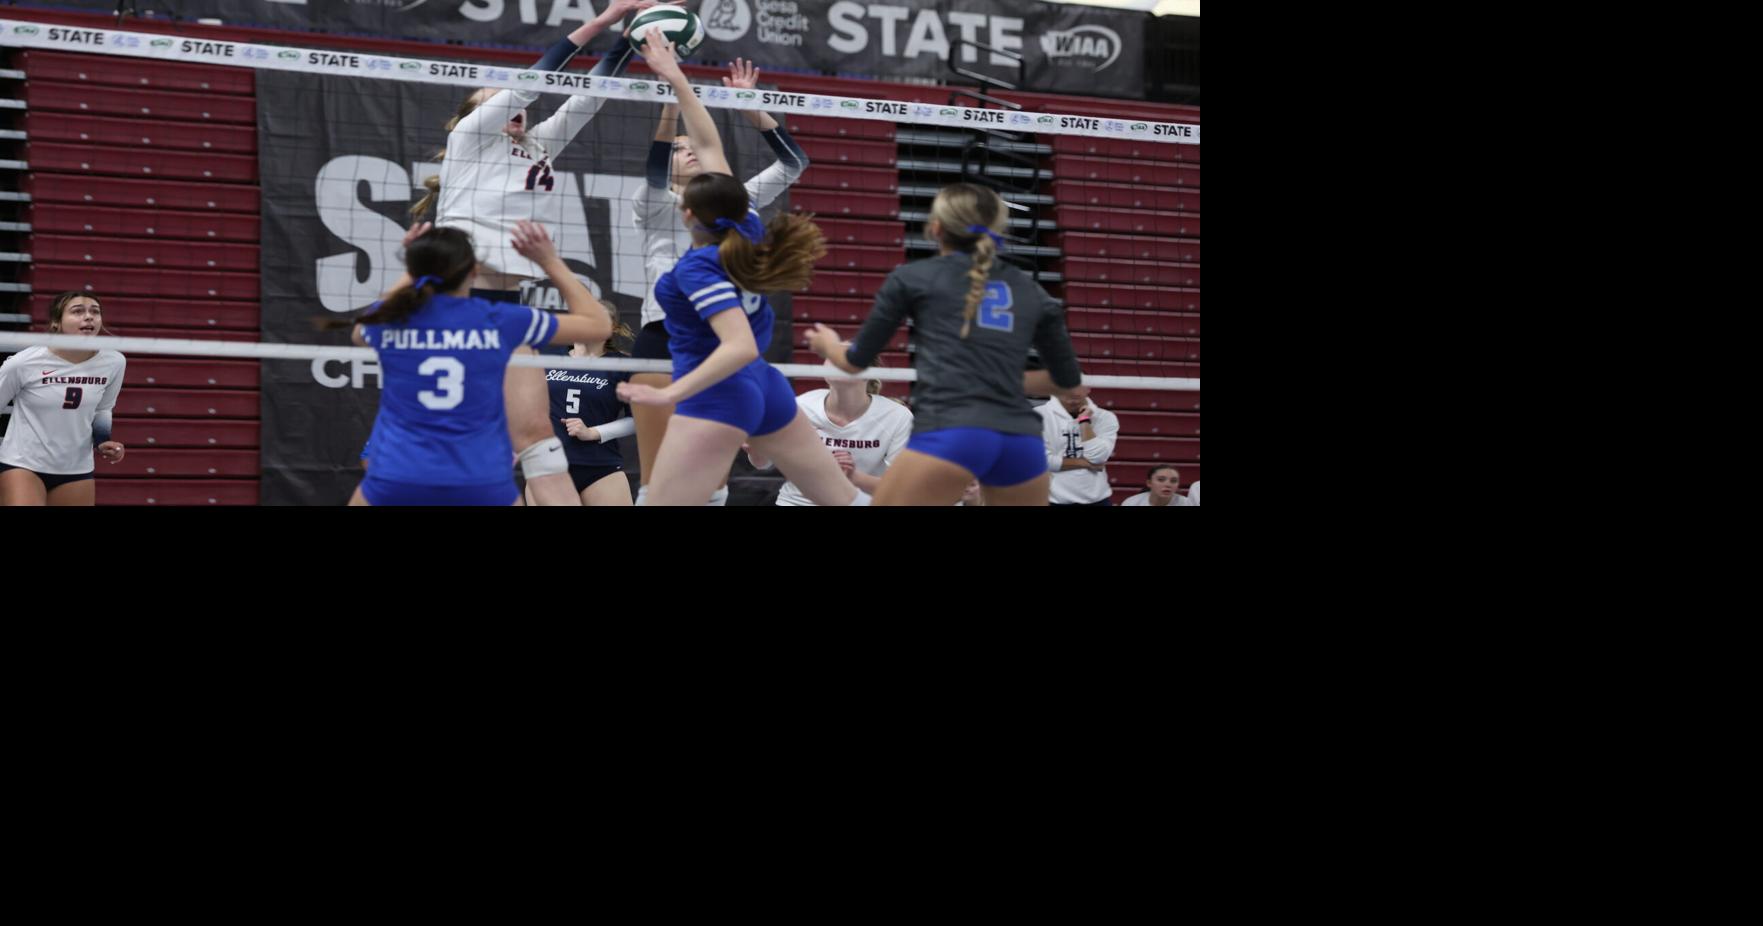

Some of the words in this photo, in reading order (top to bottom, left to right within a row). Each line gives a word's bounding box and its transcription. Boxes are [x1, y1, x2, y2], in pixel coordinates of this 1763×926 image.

[756, 10, 809, 32] Credit
[757, 26, 802, 46] Union
[827, 1, 1024, 67] STATE
[48, 28, 104, 45] STATE
[181, 40, 234, 57] STATE
[308, 52, 359, 68] STATE
[429, 63, 478, 79] STATE
[545, 73, 591, 89] STATE
[656, 84, 702, 98] STE
[762, 92, 805, 107] STATE
[866, 101, 908, 115] STATE
[963, 110, 1004, 123] STATE
[1061, 117, 1099, 130] STATE
[1154, 125, 1191, 137] STATE
[977, 280, 1014, 333] 2
[381, 329, 500, 350] PULLMAN
[42, 376, 108, 385] ELLENSBURG
[417, 356, 465, 411] 3
[545, 369, 609, 390] Ellensburg
[62, 386, 83, 410] 9
[565, 388, 581, 414] 5
[824, 437, 880, 449] ENSBURG
